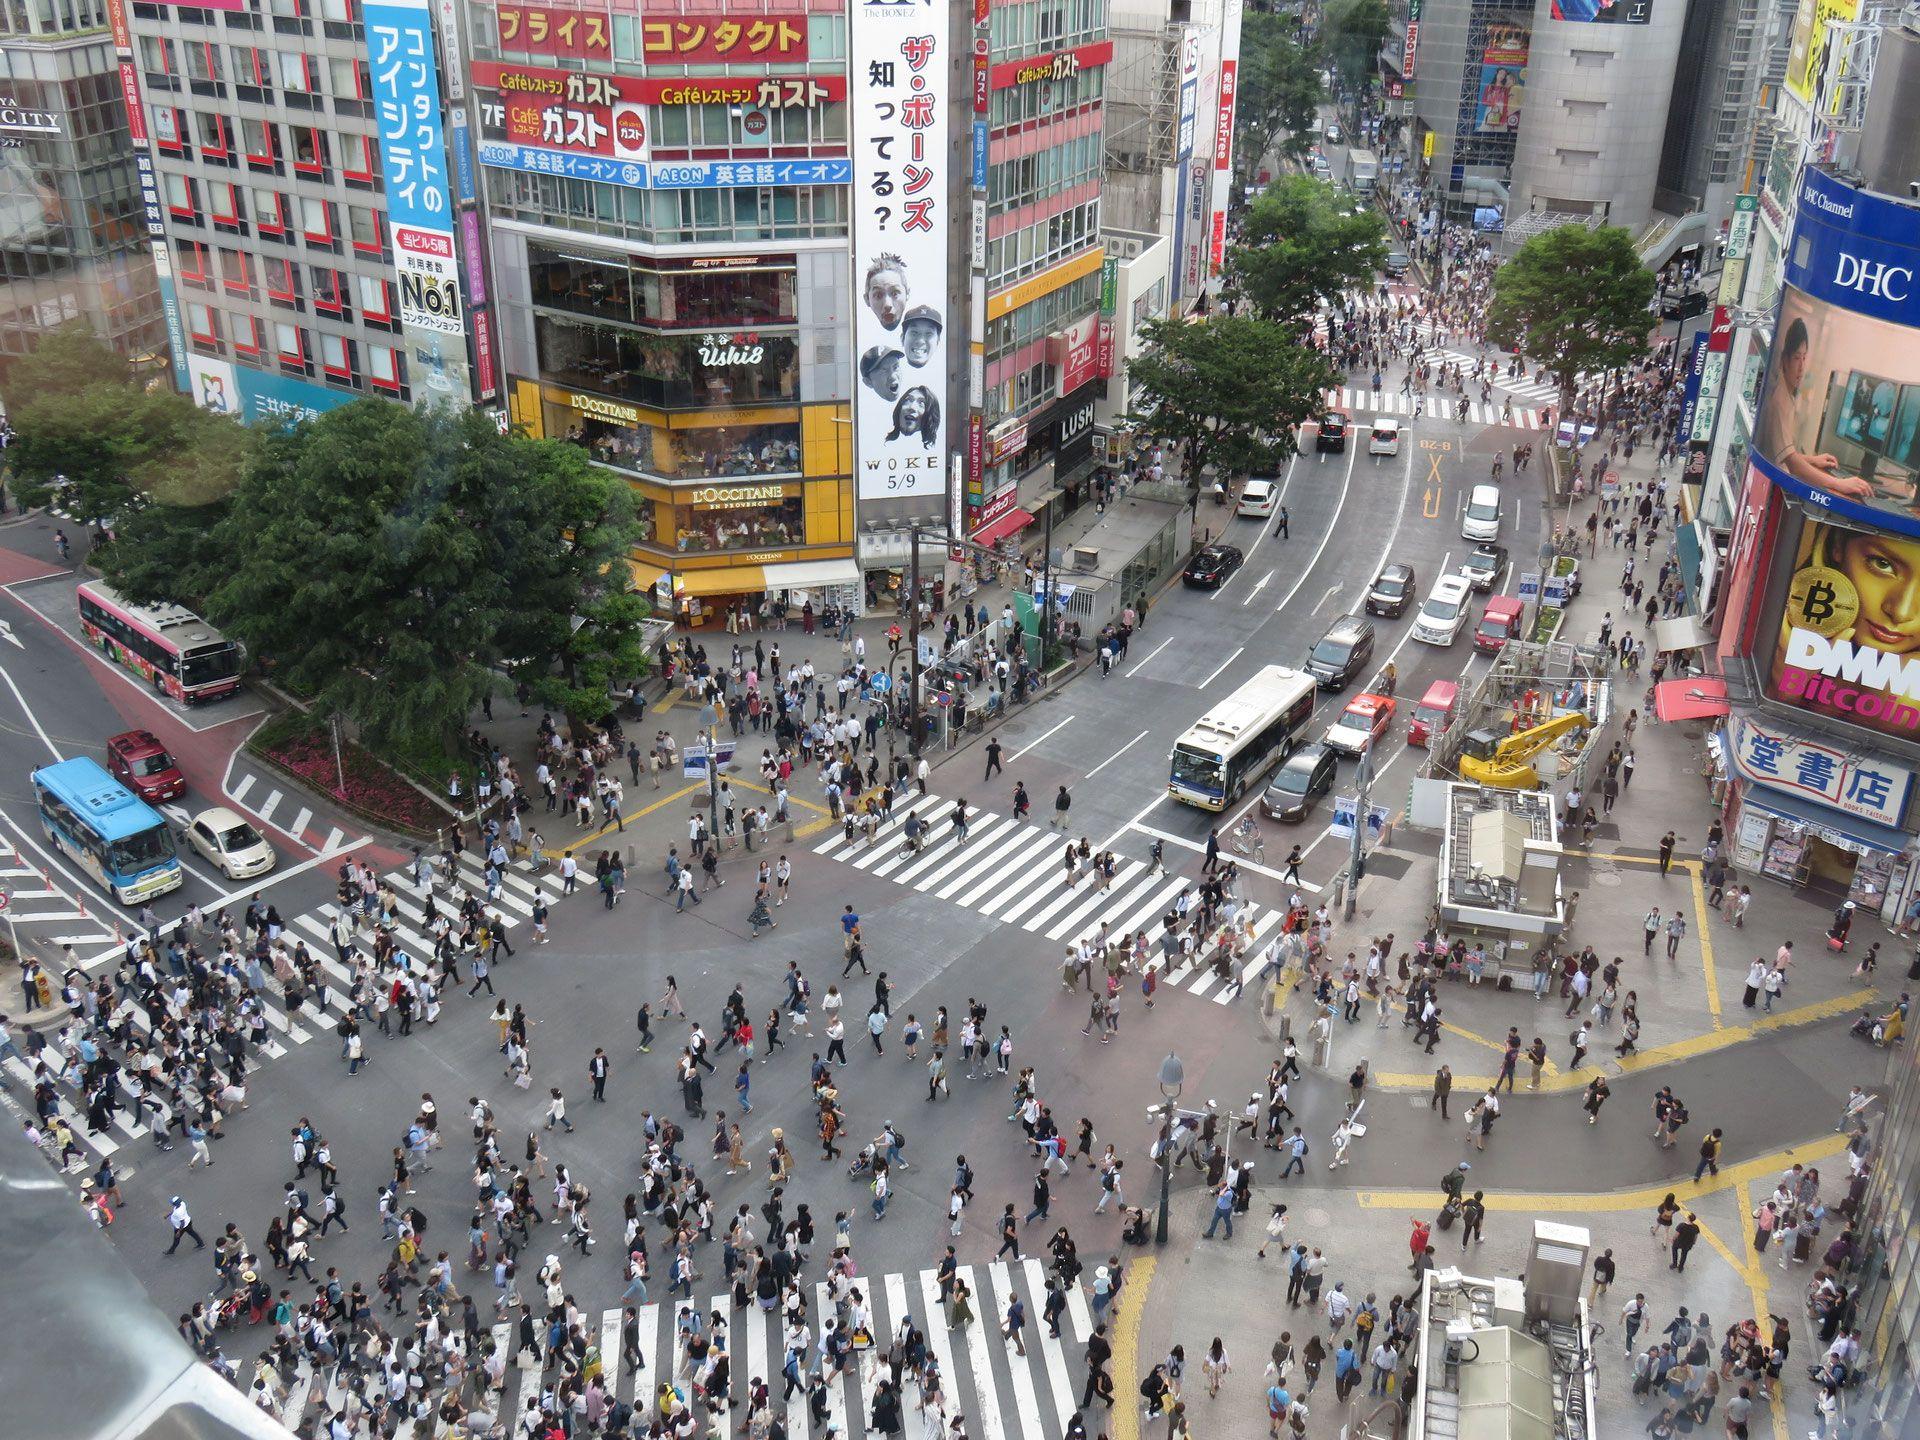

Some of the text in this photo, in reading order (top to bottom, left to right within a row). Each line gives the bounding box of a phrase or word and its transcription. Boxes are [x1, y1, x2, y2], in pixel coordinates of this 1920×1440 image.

[864, 8, 916, 17] The BONEZ
[500, 11, 608, 48] プライス
[644, 21, 802, 53] コンタクト
[1404, 27, 1417, 75] HOOTERS
[1053, 53, 1080, 81] ガスト
[500, 73, 621, 107] Caféレストラン ガスト
[660, 80, 830, 109] Caféレストラン ガスト
[976, 70, 986, 104] ガスト
[1, 109, 58, 127] CITY
[373, 25, 416, 209] アイシティ
[405, 28, 443, 213] コンタクトの
[482, 104, 505, 127] 7F
[511, 107, 539, 126] Café
[542, 106, 608, 148] ガスト
[747, 120, 765, 129] ガスト
[1217, 72, 1233, 159] 免税 TaxFree
[620, 127, 643, 140] ガスト
[869, 60, 895, 231] 知ってる?
[901, 35, 936, 233] ザ・ボーンズ
[484, 147, 514, 164] AEON
[523, 150, 618, 179] 英会話イーオン
[659, 168, 704, 184] AEON
[716, 163, 848, 185] 英会話イーオン
[1804, 186, 1854, 219] DHC Channel
[150, 223, 162, 233] 5F
[403, 232, 449, 255] 当ビル5階
[407, 256, 443, 274] 利用者数
[1833, 252, 1913, 302] DHC
[399, 270, 461, 320] No.1
[404, 312, 462, 333] コンタクトショップ
[698, 345, 765, 367] Ushi8
[1070, 344, 1092, 372] アコム
[1694, 341, 1708, 376] MIZUHO
[570, 394, 639, 421] L'OCCITANE
[1061, 402, 1094, 442] LUSH
[693, 485, 783, 503] L'OCCITANE
[887, 474, 916, 490] 5/9
[724, 501, 768, 509] PROVENCE
[1810, 490, 1832, 507] DHC
[1785, 627, 1920, 700] DMM
[1778, 667, 1920, 730] Bitcoin
[1843, 802, 1893, 823] BOOKS TAISEIDO
